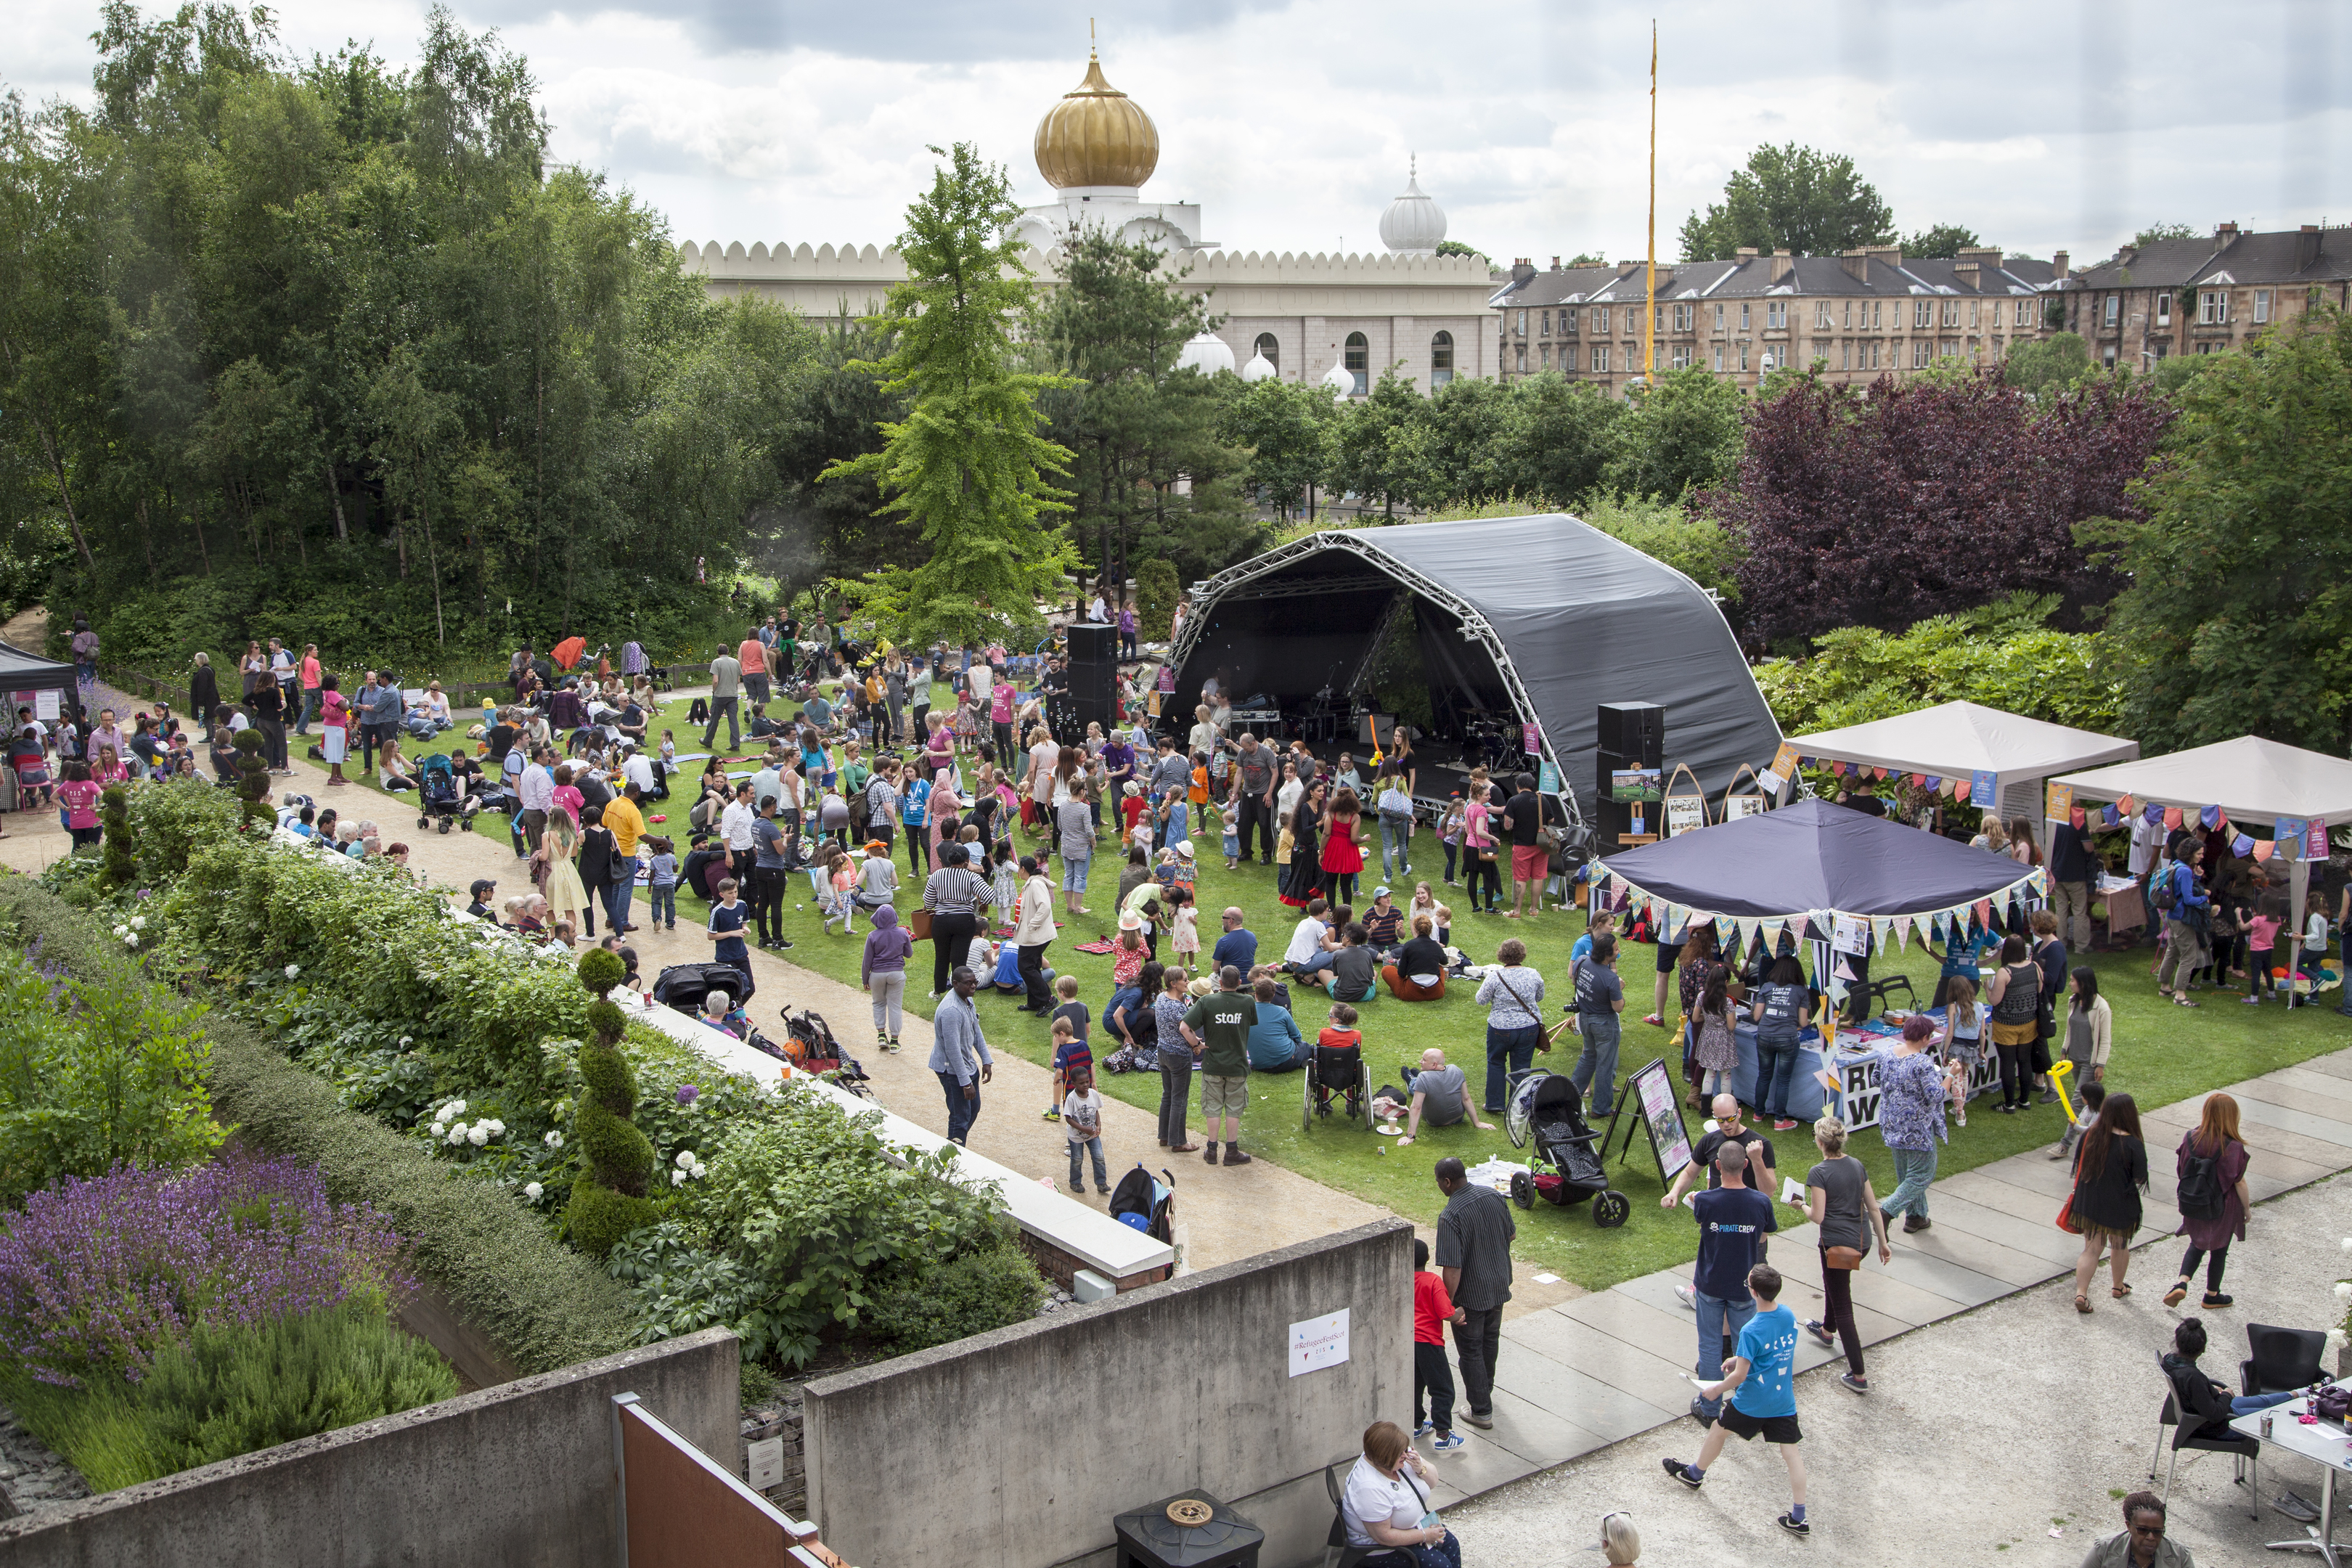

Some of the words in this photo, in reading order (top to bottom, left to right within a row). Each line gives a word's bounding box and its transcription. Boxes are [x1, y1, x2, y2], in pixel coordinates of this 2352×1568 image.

[1580, 967, 1591, 976] LEST
[1580, 971, 1593, 982] FORGET
[1214, 1013, 1242, 1024] staff
[1294, 1331, 1345, 1350] #RefugeeFestScot
